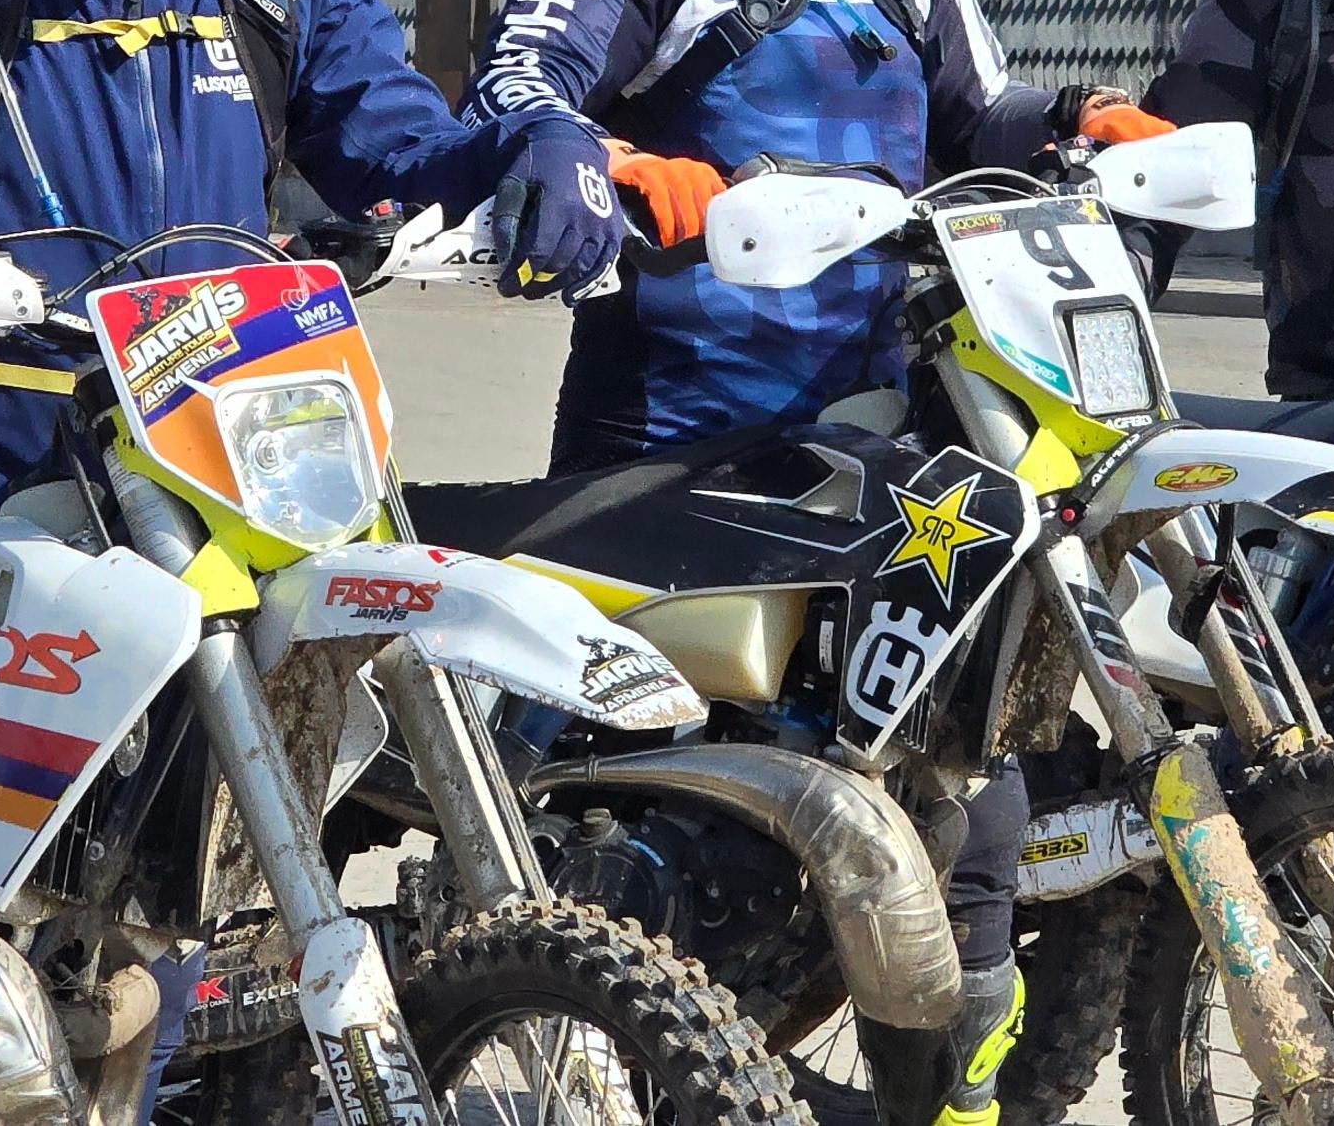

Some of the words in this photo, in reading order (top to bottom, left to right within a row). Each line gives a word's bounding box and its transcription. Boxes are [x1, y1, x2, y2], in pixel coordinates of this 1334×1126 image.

[192, 74, 250, 95] Husqva
[124, 281, 246, 382] JARVIS
[294, 301, 343, 329] NMFA
[142, 344, 224, 411] ARMENIA
[607, 678, 672, 712] ARMENIA
[1020, 837, 1084, 862] ERBIS
[323, 1039, 369, 1126] ARME
